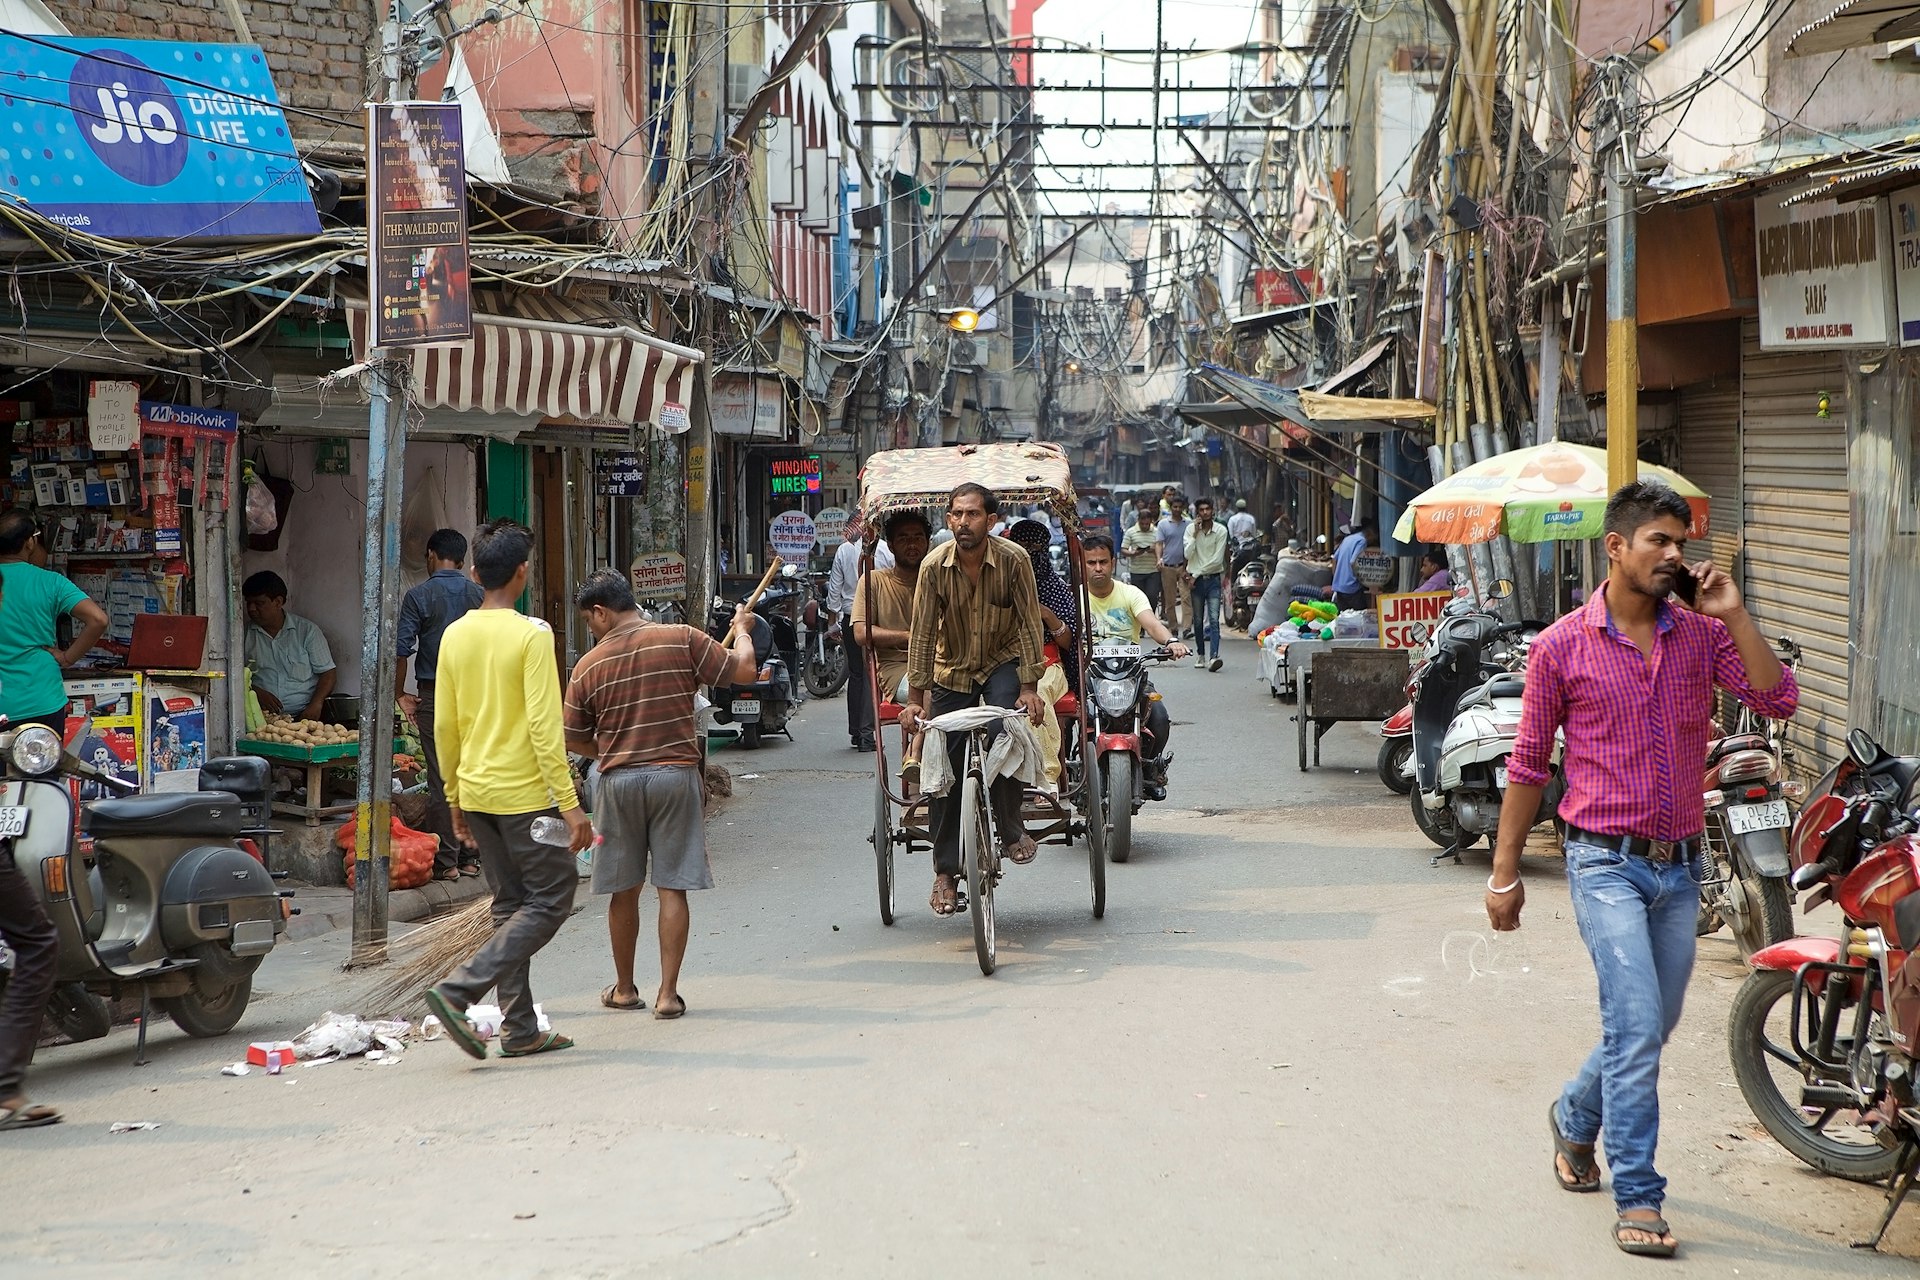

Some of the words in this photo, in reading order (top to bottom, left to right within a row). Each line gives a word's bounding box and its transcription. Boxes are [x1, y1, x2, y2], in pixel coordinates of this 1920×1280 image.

[188, 91, 279, 116] DIGITAL
[91, 82, 178, 144] Jio
[198, 121, 249, 144] LIFE
[385, 224, 403, 237] THE
[404, 222, 439, 236] WALLED
[440, 221, 459, 234] CITY
[1804, 284, 1827, 315] SARAF
[104, 400, 120, 410] TO
[150, 405, 227, 428] MobiKwik
[98, 433, 133, 446] REPAIR
[771, 459, 819, 475] WINDING
[618, 482, 626, 495] है
[771, 476, 807, 493] WIRES
[1747, 803, 1780, 818] DL7S
[1741, 813, 1787, 831] AL1567
